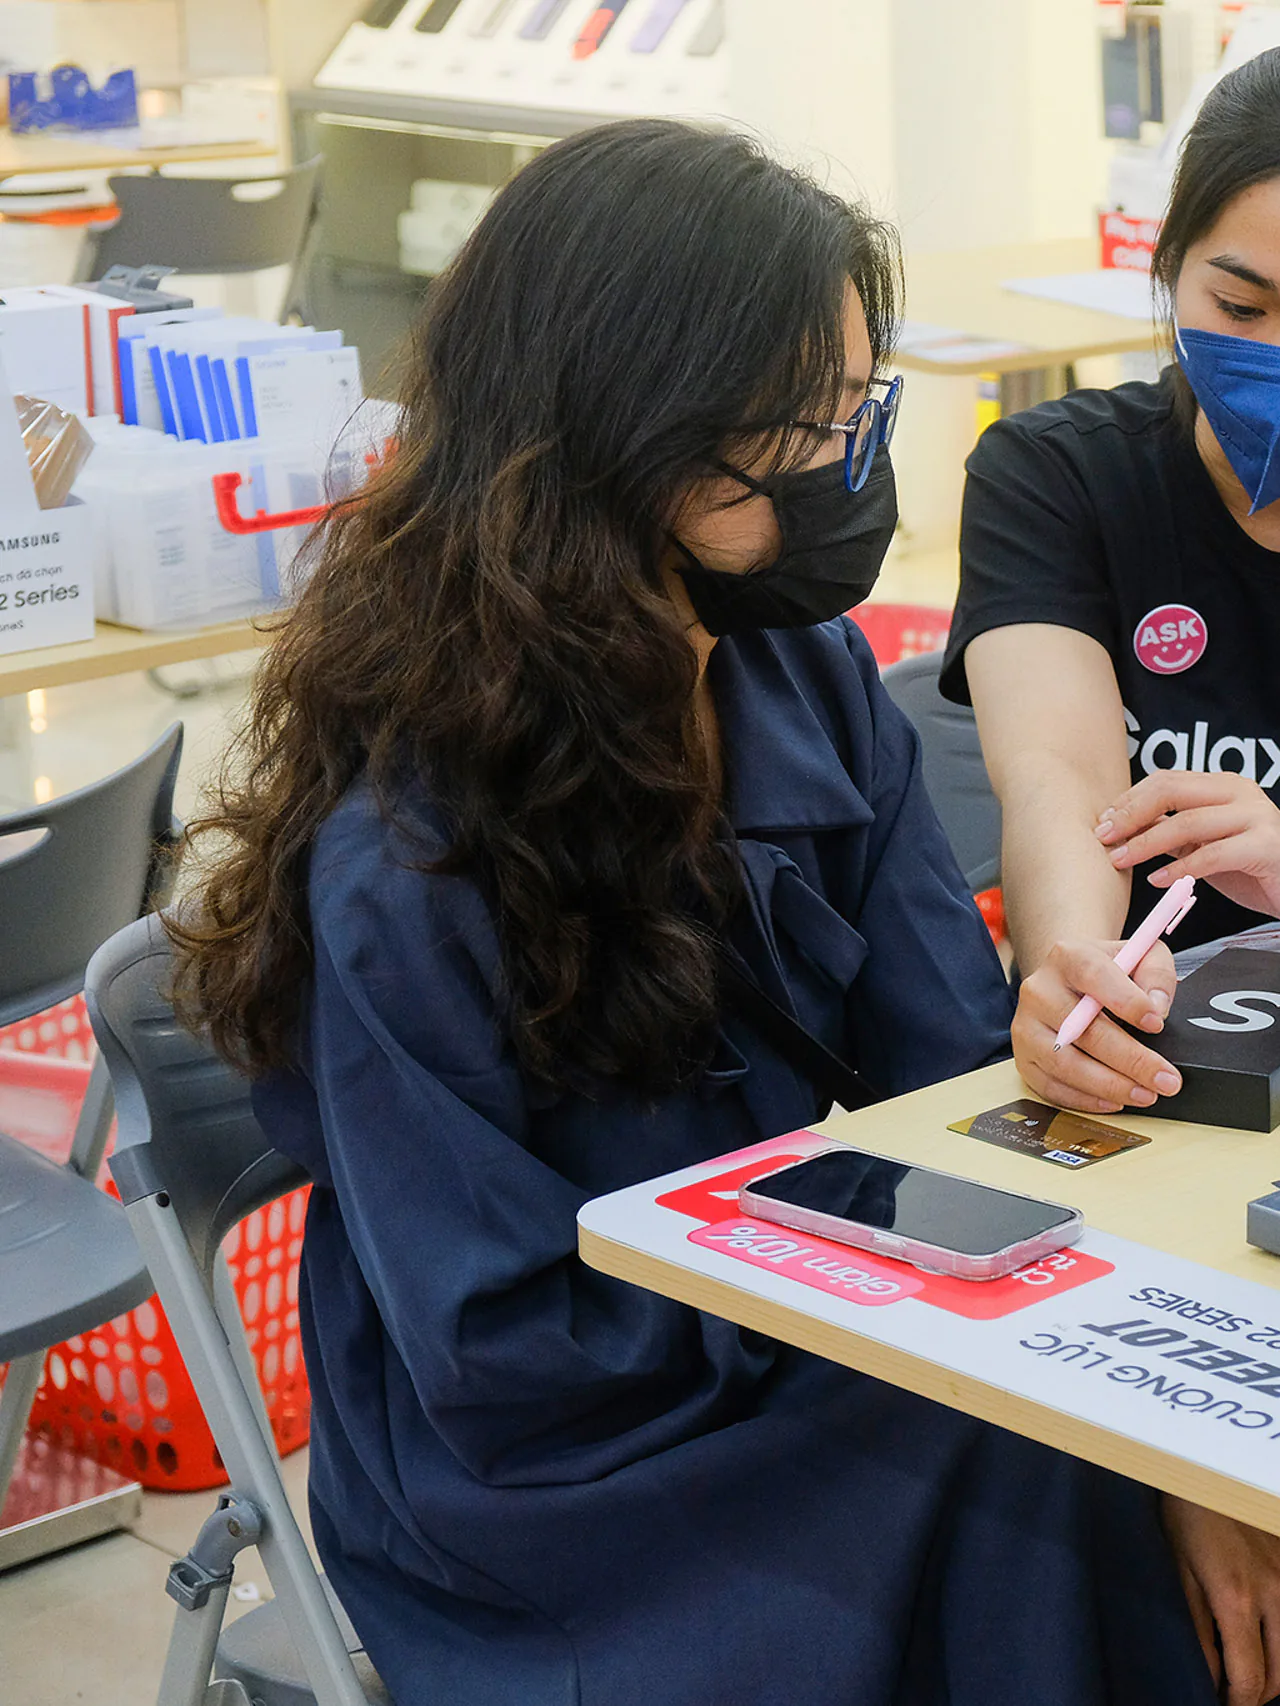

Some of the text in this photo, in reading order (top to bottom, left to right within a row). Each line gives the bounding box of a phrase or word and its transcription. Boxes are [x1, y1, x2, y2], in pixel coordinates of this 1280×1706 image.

[14, 583, 80, 608] Series
[1140, 617, 1200, 647] ASK
[1051, 1151, 1081, 1165] VISA
[704, 1225, 814, 1264] 10%
[1129, 1287, 1254, 1332] SERIES
[1019, 1333, 1113, 1370] LỰC
[1106, 1365, 1274, 1430] CƯỜNG
